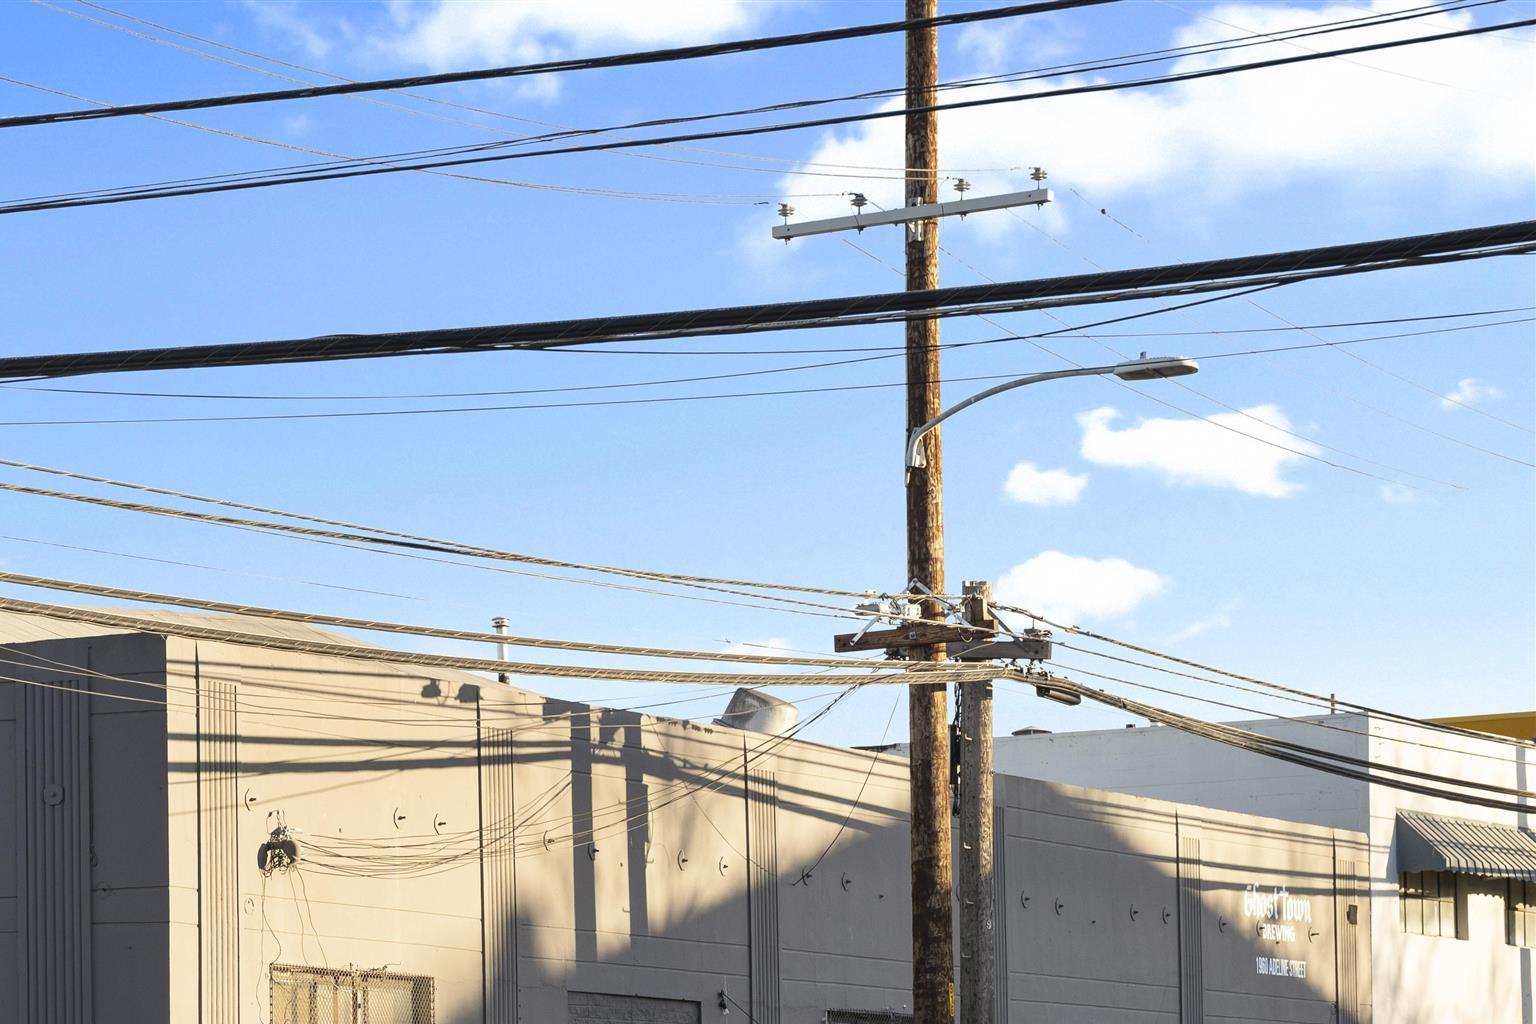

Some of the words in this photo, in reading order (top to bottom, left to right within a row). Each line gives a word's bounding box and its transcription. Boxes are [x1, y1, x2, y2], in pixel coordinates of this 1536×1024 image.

[1244, 882, 1279, 920] Ghost
[1279, 884, 1312, 923] Town
[1262, 923, 1296, 942] BREWING
[1256, 957, 1269, 975] 1960
[1269, 958, 1289, 976] ADELINE
[1289, 960, 1306, 978] STREET
